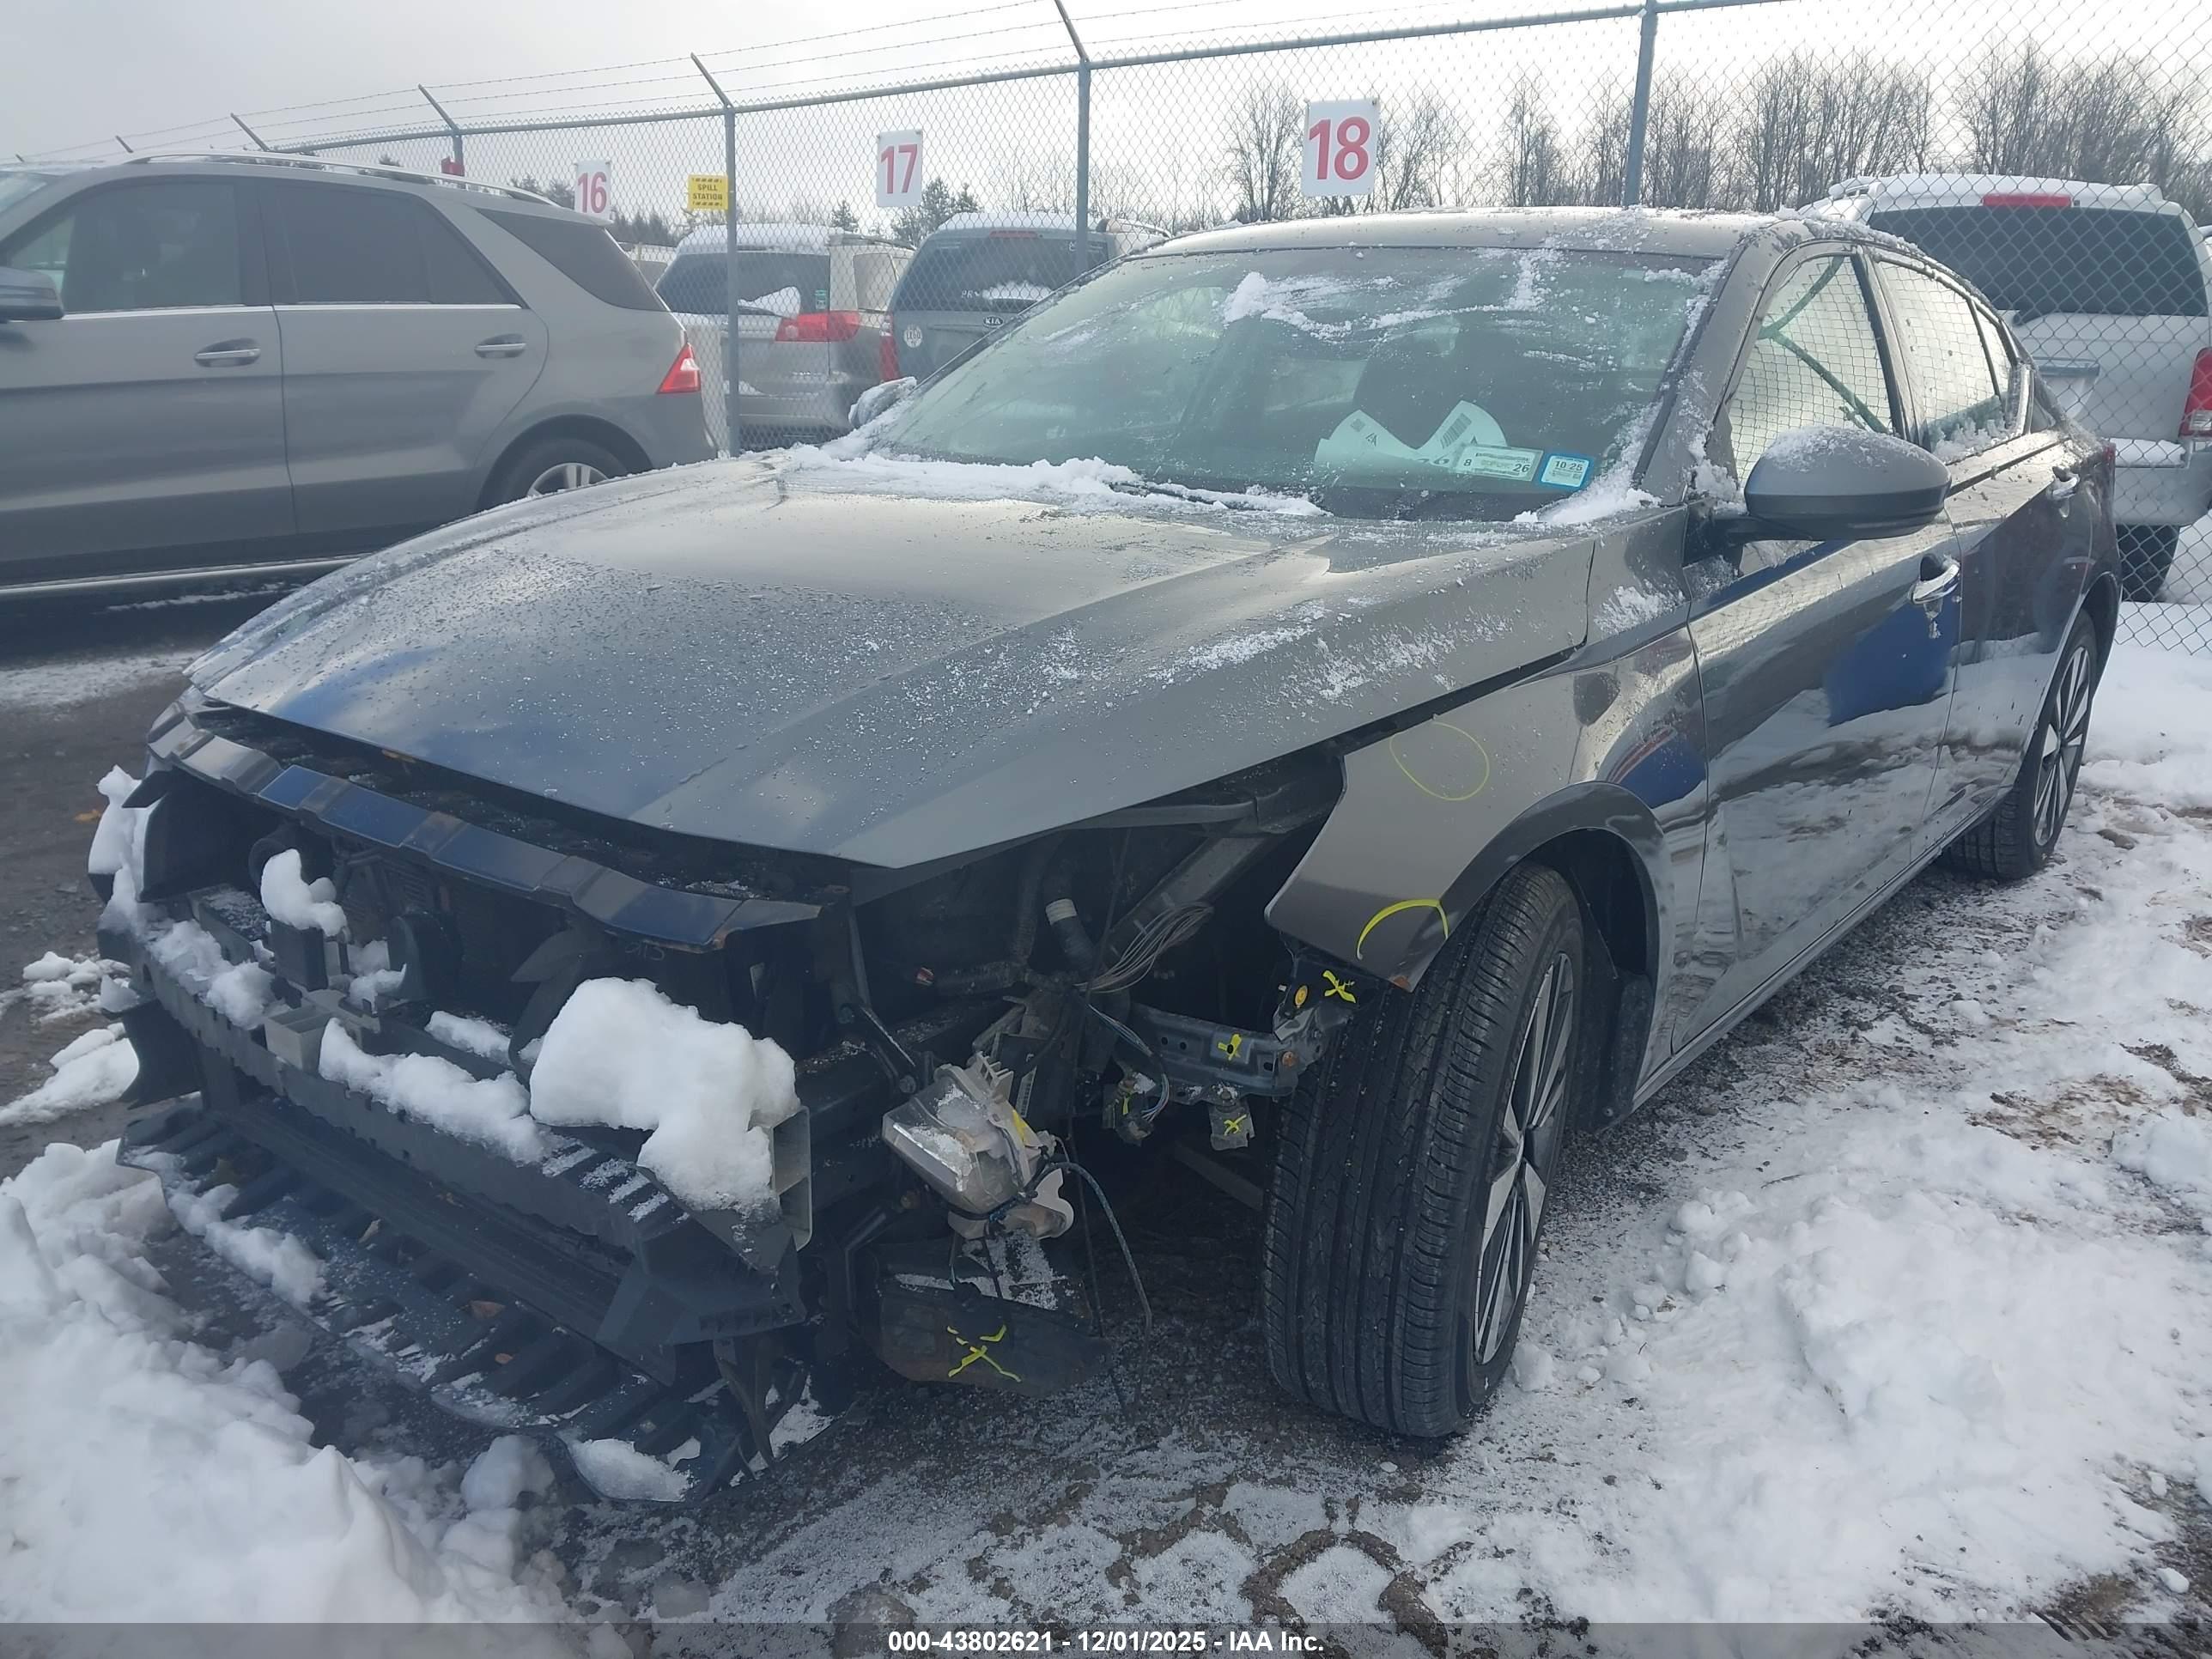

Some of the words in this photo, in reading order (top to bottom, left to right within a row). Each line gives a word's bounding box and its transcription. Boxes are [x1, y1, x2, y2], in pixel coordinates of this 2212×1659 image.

[880, 143, 918, 194] 17
[1309, 116, 1371, 180] 18
[577, 171, 607, 214] 16
[1463, 459, 1472, 467] 8
[1512, 463, 1531, 473] 26
[1555, 460, 1567, 469] 10
[1569, 462, 1583, 471] 25
